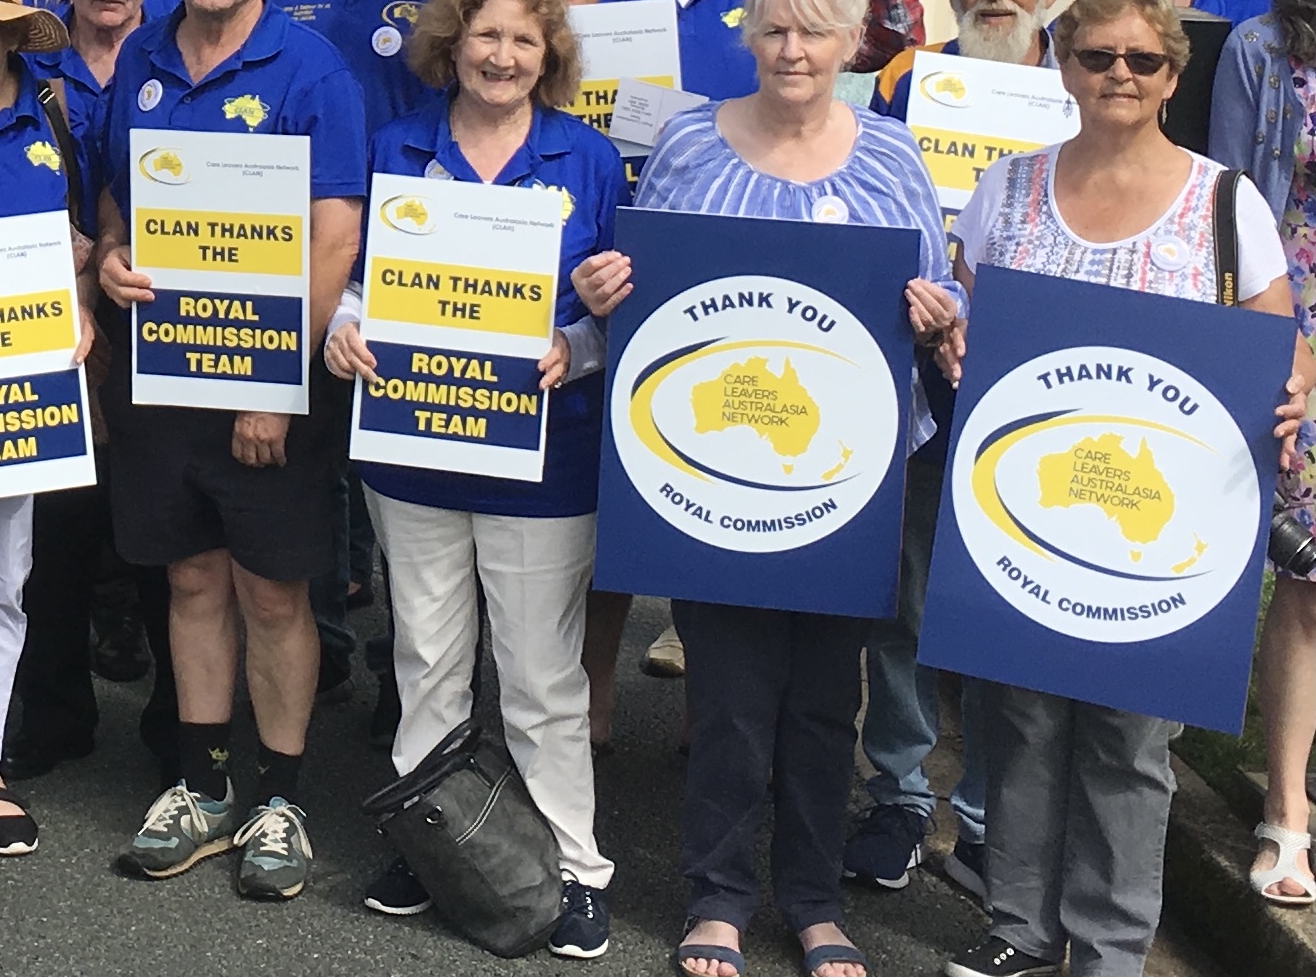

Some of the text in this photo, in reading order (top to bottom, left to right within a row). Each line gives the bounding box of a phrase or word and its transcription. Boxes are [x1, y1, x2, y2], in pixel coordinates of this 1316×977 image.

[918, 136, 976, 159] CLAN
[145, 219, 293, 242] CLAN THANKS
[198, 245, 239, 263] THE
[381, 269, 542, 302] CLAN THANKS
[179, 296, 259, 321] ROYAL
[438, 299, 481, 320] THE
[683, 291, 837, 334] THANK YOU
[142, 322, 297, 351] COMMISSION
[186, 352, 252, 376] TEAM
[411, 352, 498, 382] ROYAL
[724, 374, 759, 387] CARE
[1036, 363, 1201, 417] THANK YOU
[368, 377, 538, 416] COMMISSION
[724, 387, 778, 401] LEAVERS
[721, 411, 790, 428] NETWORK
[722, 399, 809, 416] AUSTRALASIA
[414, 410, 487, 438] TEAM
[1074, 447, 1111, 464] CARE
[1072, 461, 1131, 481] LEAVERS
[1068, 486, 1141, 511] NETWORK
[1070, 475, 1162, 502] AUSTRALASIA
[659, 483, 838, 533] ROYAL COMMISSION
[995, 554, 1187, 622] ROYAL COMMISSION
